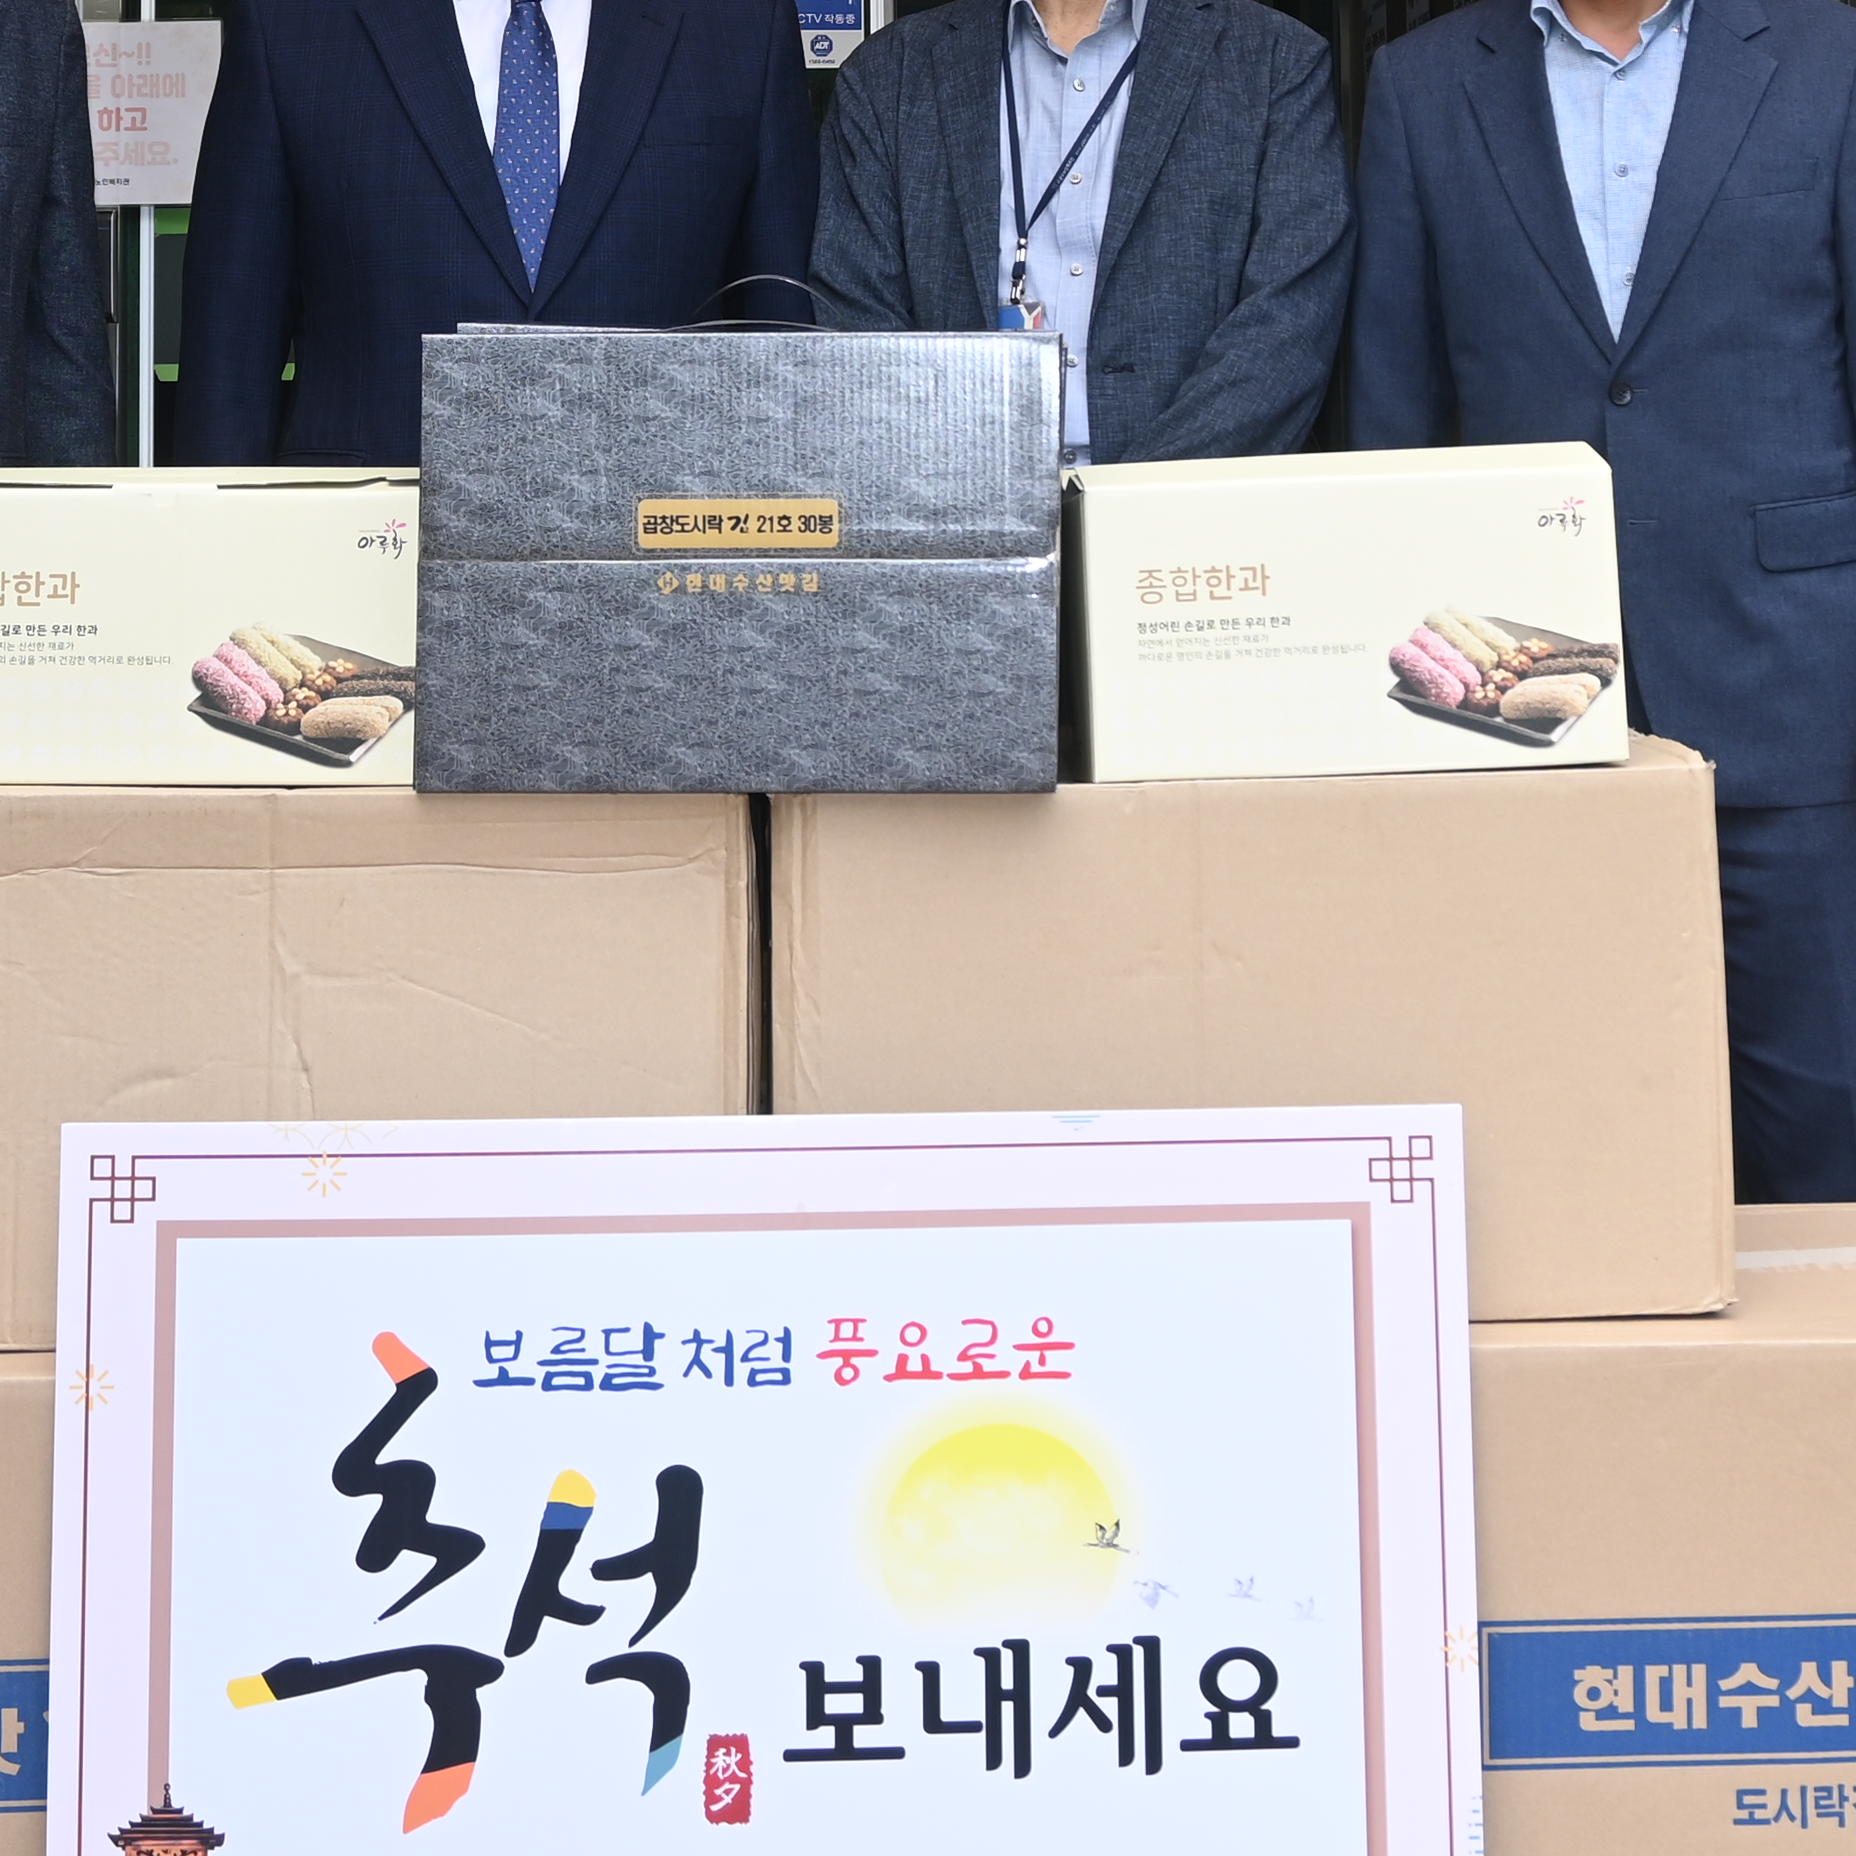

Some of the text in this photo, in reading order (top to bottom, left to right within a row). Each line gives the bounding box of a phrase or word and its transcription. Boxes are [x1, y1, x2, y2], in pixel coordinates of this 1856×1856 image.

[798, 13, 823, 24] CTV
[824, 13, 856, 25] 작동중
[111, 72, 187, 99] 아래에
[642, 514, 723, 535] 곱창도시락
[756, 514, 793, 534] 21호
[798, 514, 834, 535] 30봉
[1136, 563, 1271, 605] 종합한과
[25, 624, 47, 637] 만든
[51, 624, 72, 637] 우리
[76, 624, 98, 637] 한과
[1137, 616, 1291, 635] 정성어린 손길로 만든 우리 한과
[815, 1316, 1076, 1388] 풍요로운
[226, 1330, 707, 1835] 추석
[782, 1635, 1301, 1778] 보내세요
[1572, 1660, 1852, 1732] 현대수산
[709, 1746, 748, 1812] 秋夕
